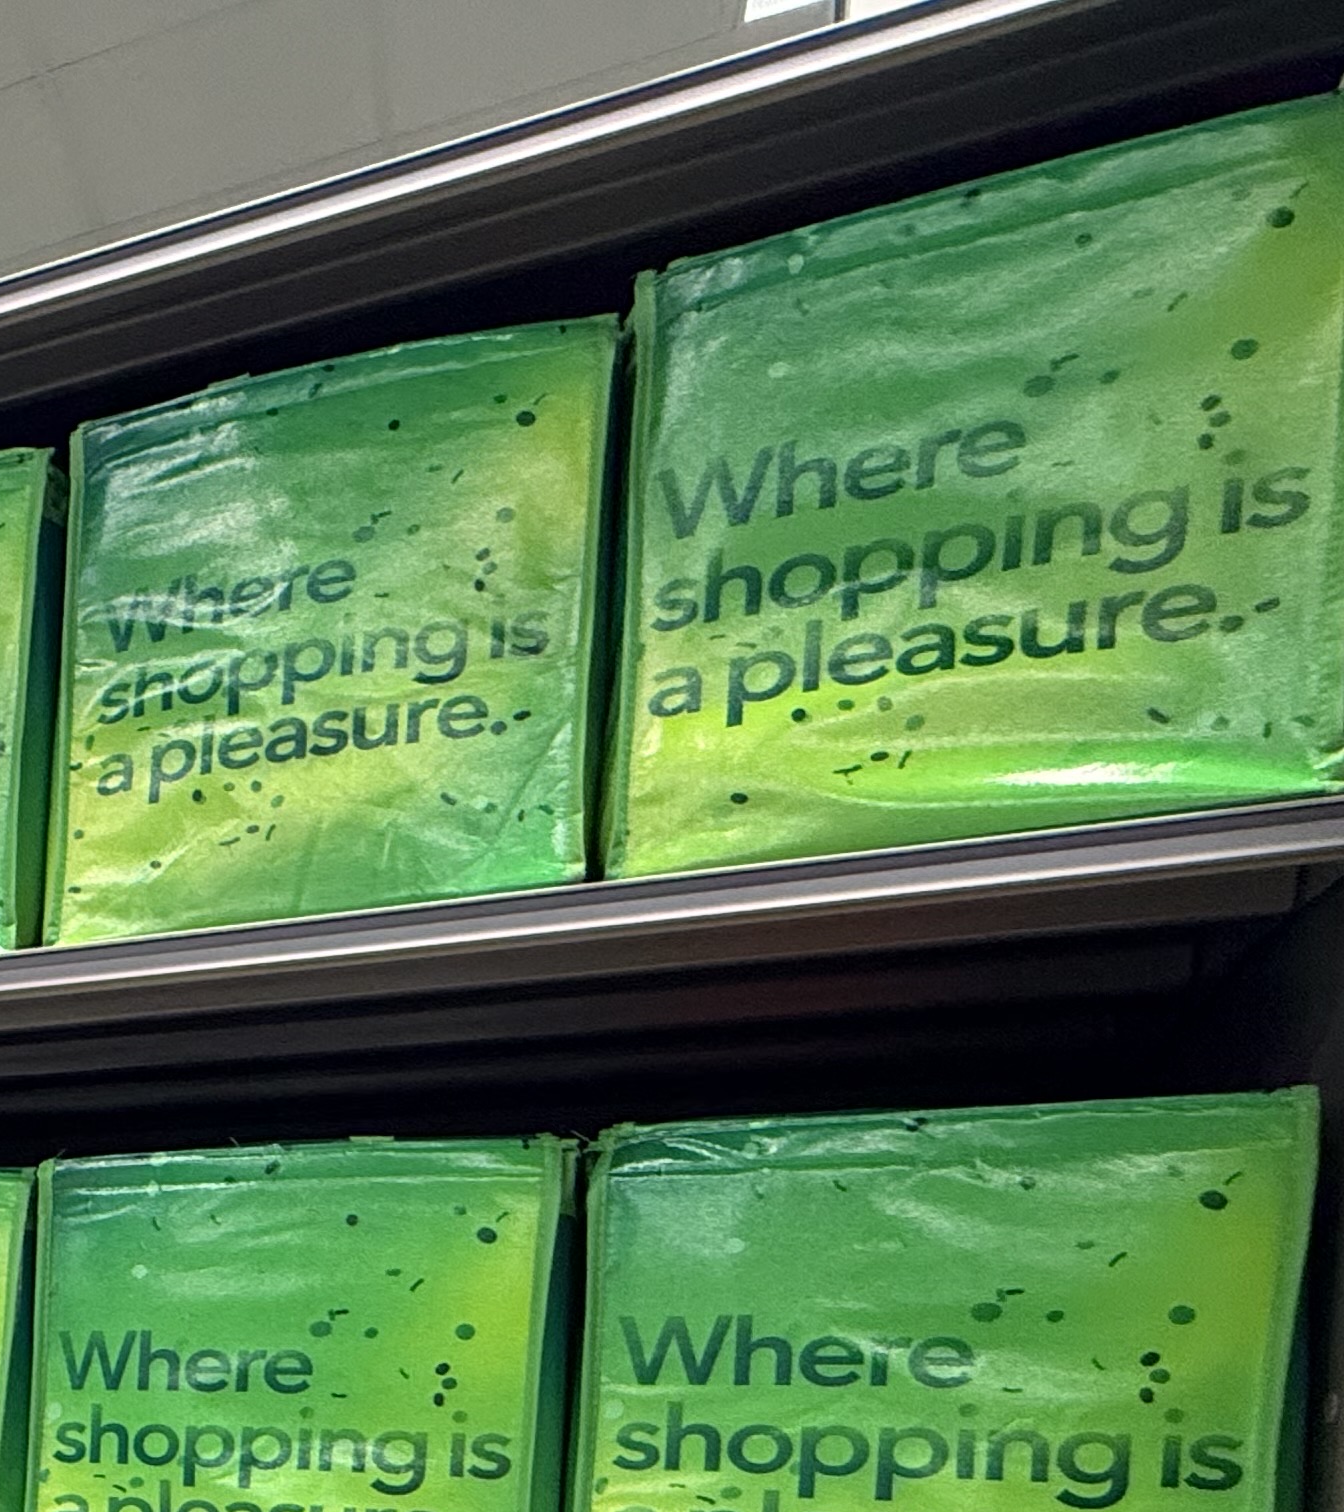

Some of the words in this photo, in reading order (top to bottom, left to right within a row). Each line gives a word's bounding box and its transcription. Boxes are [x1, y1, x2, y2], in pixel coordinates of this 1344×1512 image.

[662, 415, 1028, 527] Where
[653, 493, 1190, 631] shopping
[1224, 458, 1313, 535] is
[649, 658, 702, 721] a
[728, 583, 1244, 729] pleasure.
[621, 1315, 979, 1389] Where
[612, 1404, 1132, 1509] shopping
[1163, 1425, 1242, 1491] is
